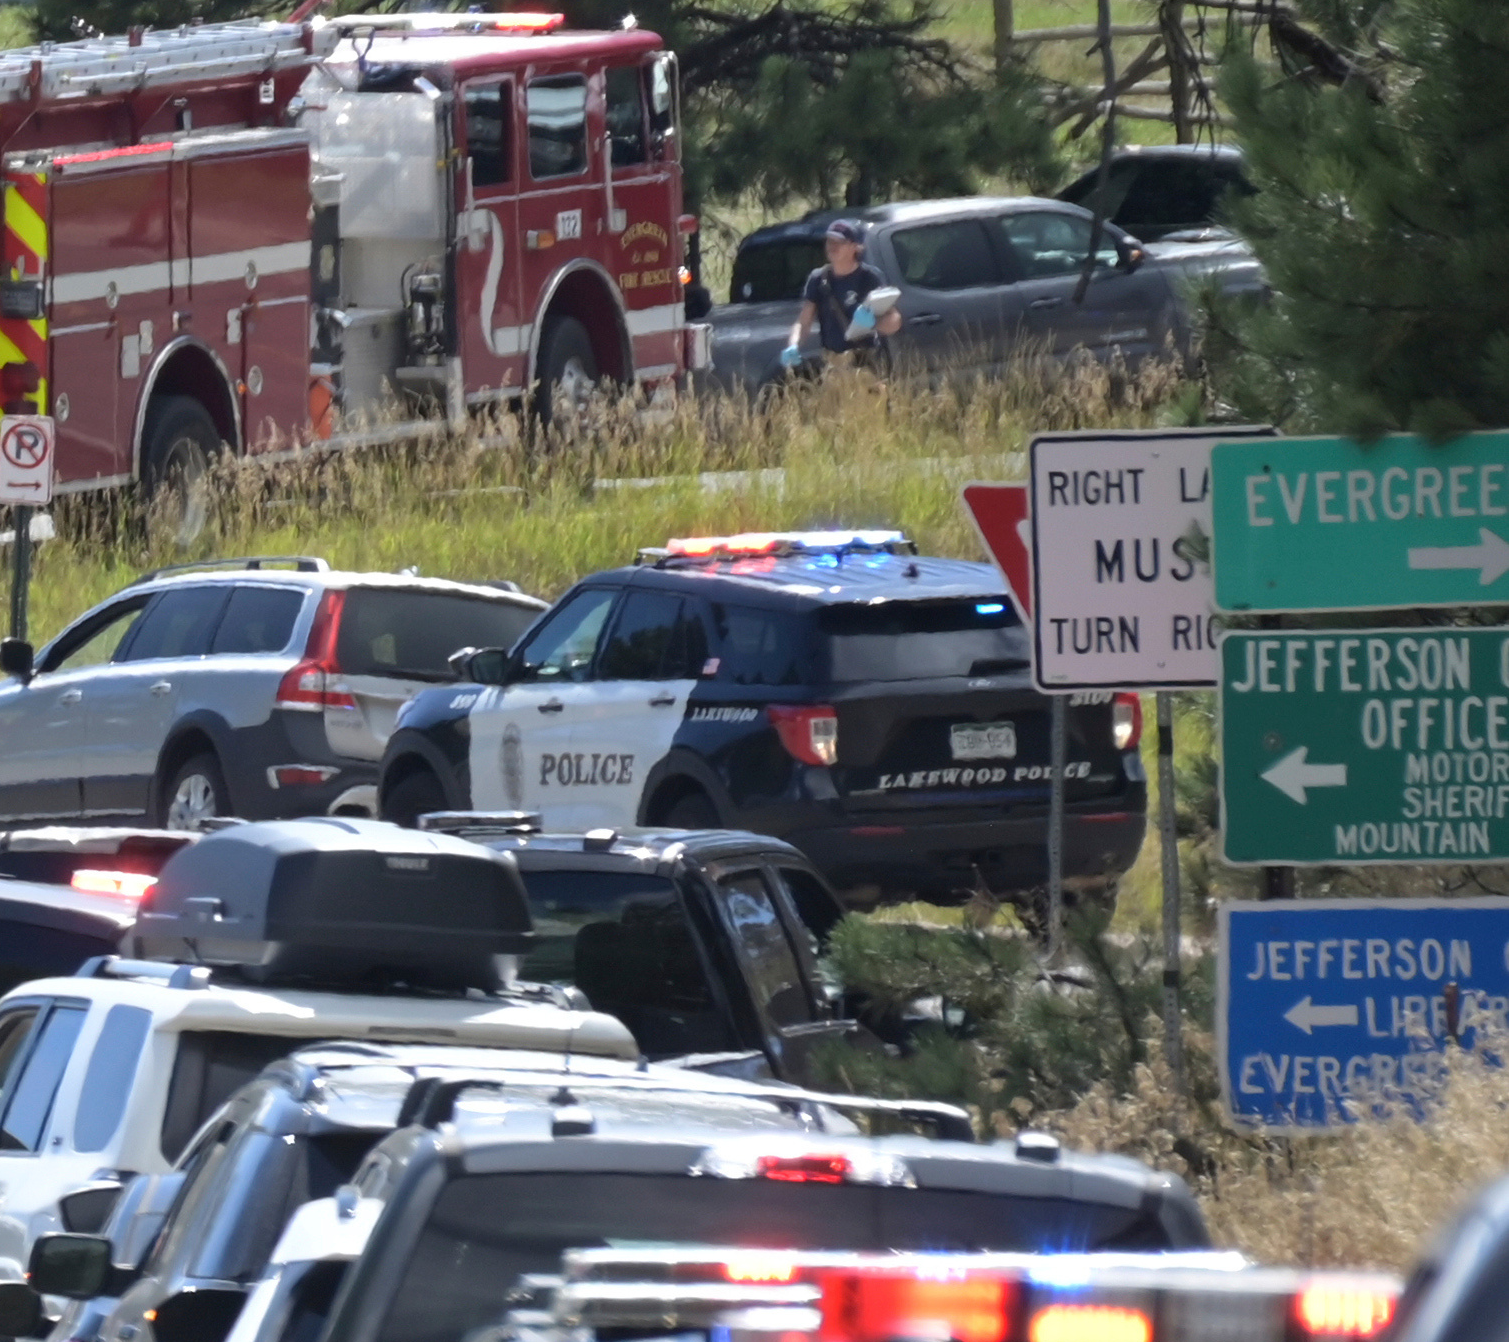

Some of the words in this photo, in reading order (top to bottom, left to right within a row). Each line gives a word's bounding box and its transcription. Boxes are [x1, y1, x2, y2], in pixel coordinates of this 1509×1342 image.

[1048, 469, 1145, 506] RIGHT
[1050, 616, 1141, 655] TURN
[1231, 637, 1471, 693] JEFFERSON
[539, 753, 635, 787] POLICE
[879, 767, 1007, 790] LAKEWOOD
[1013, 761, 1092, 782] POLCE
[1334, 820, 1491, 856] MOUNTAIN
[1246, 938, 1472, 981] JEFFERSON
